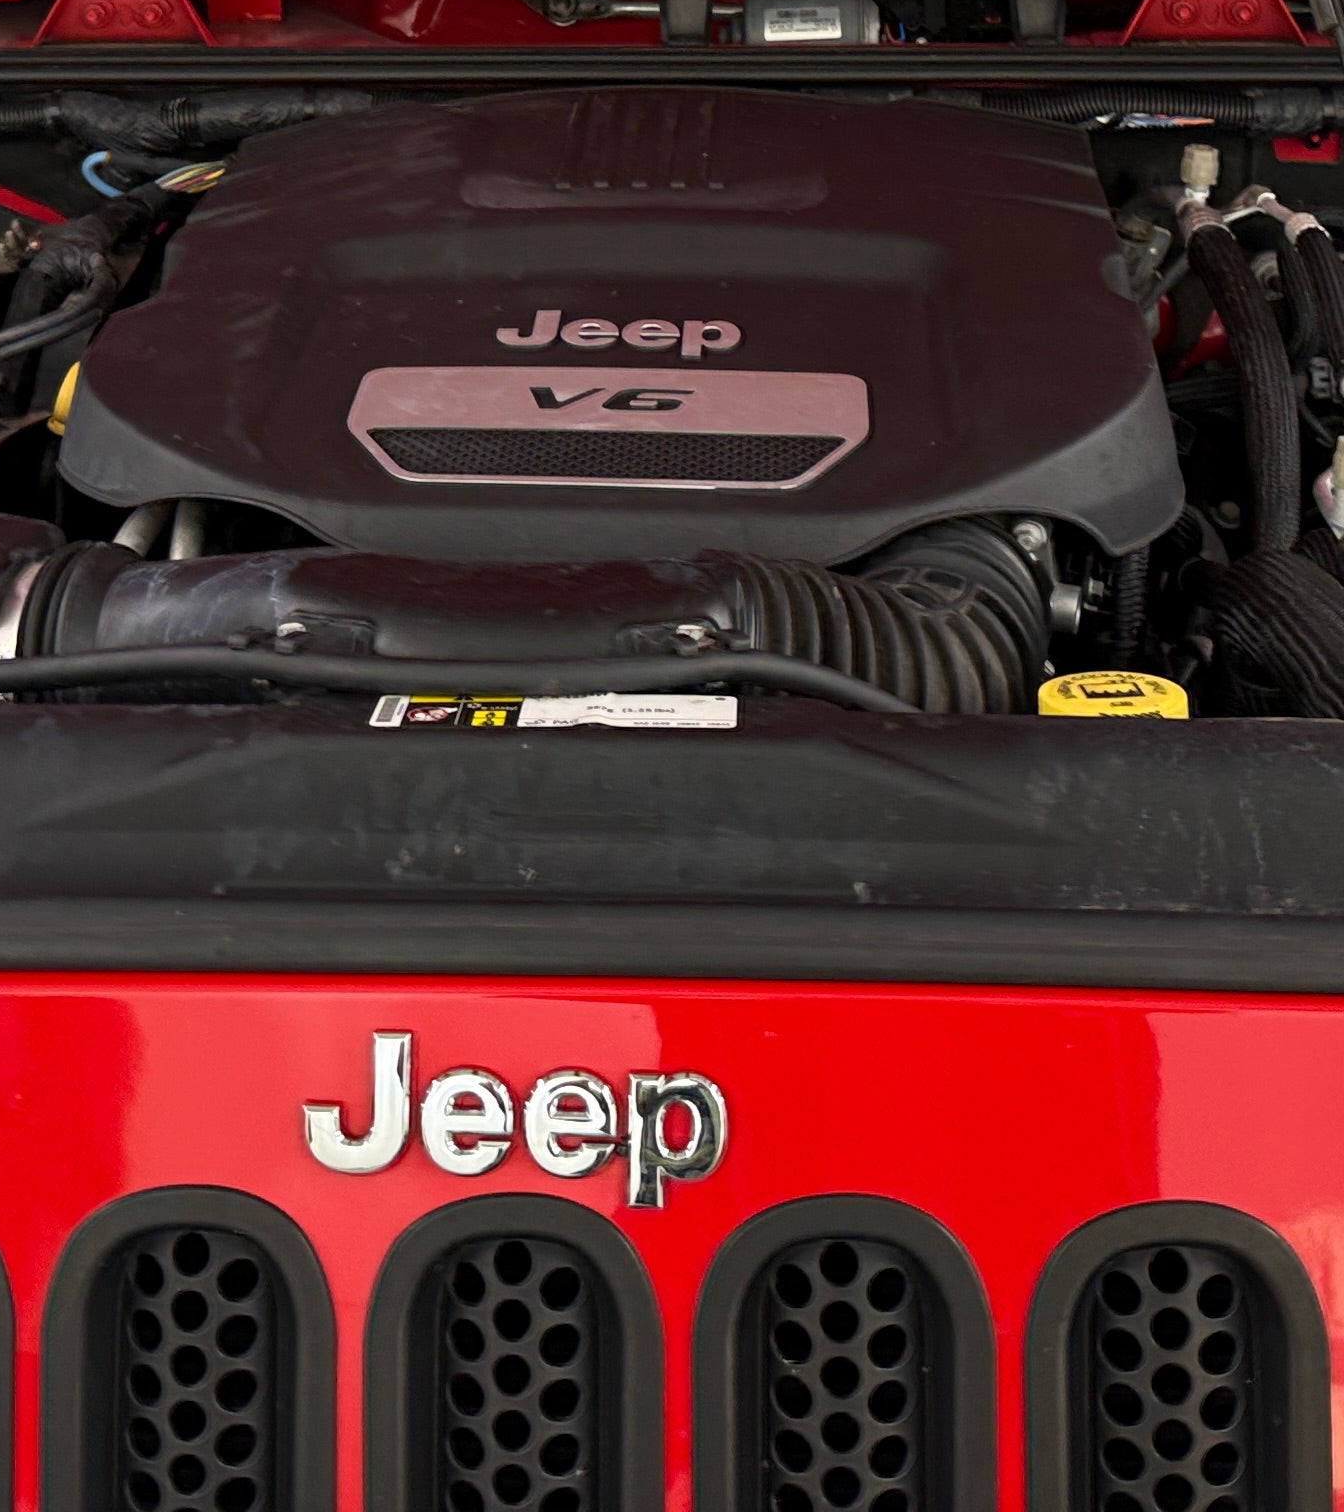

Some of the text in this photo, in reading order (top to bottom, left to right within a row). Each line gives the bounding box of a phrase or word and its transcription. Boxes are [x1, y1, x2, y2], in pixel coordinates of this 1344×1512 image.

[496, 309, 742, 359] Jeep
[529, 386, 695, 412] V6
[301, 1028, 729, 1210] Jeep
